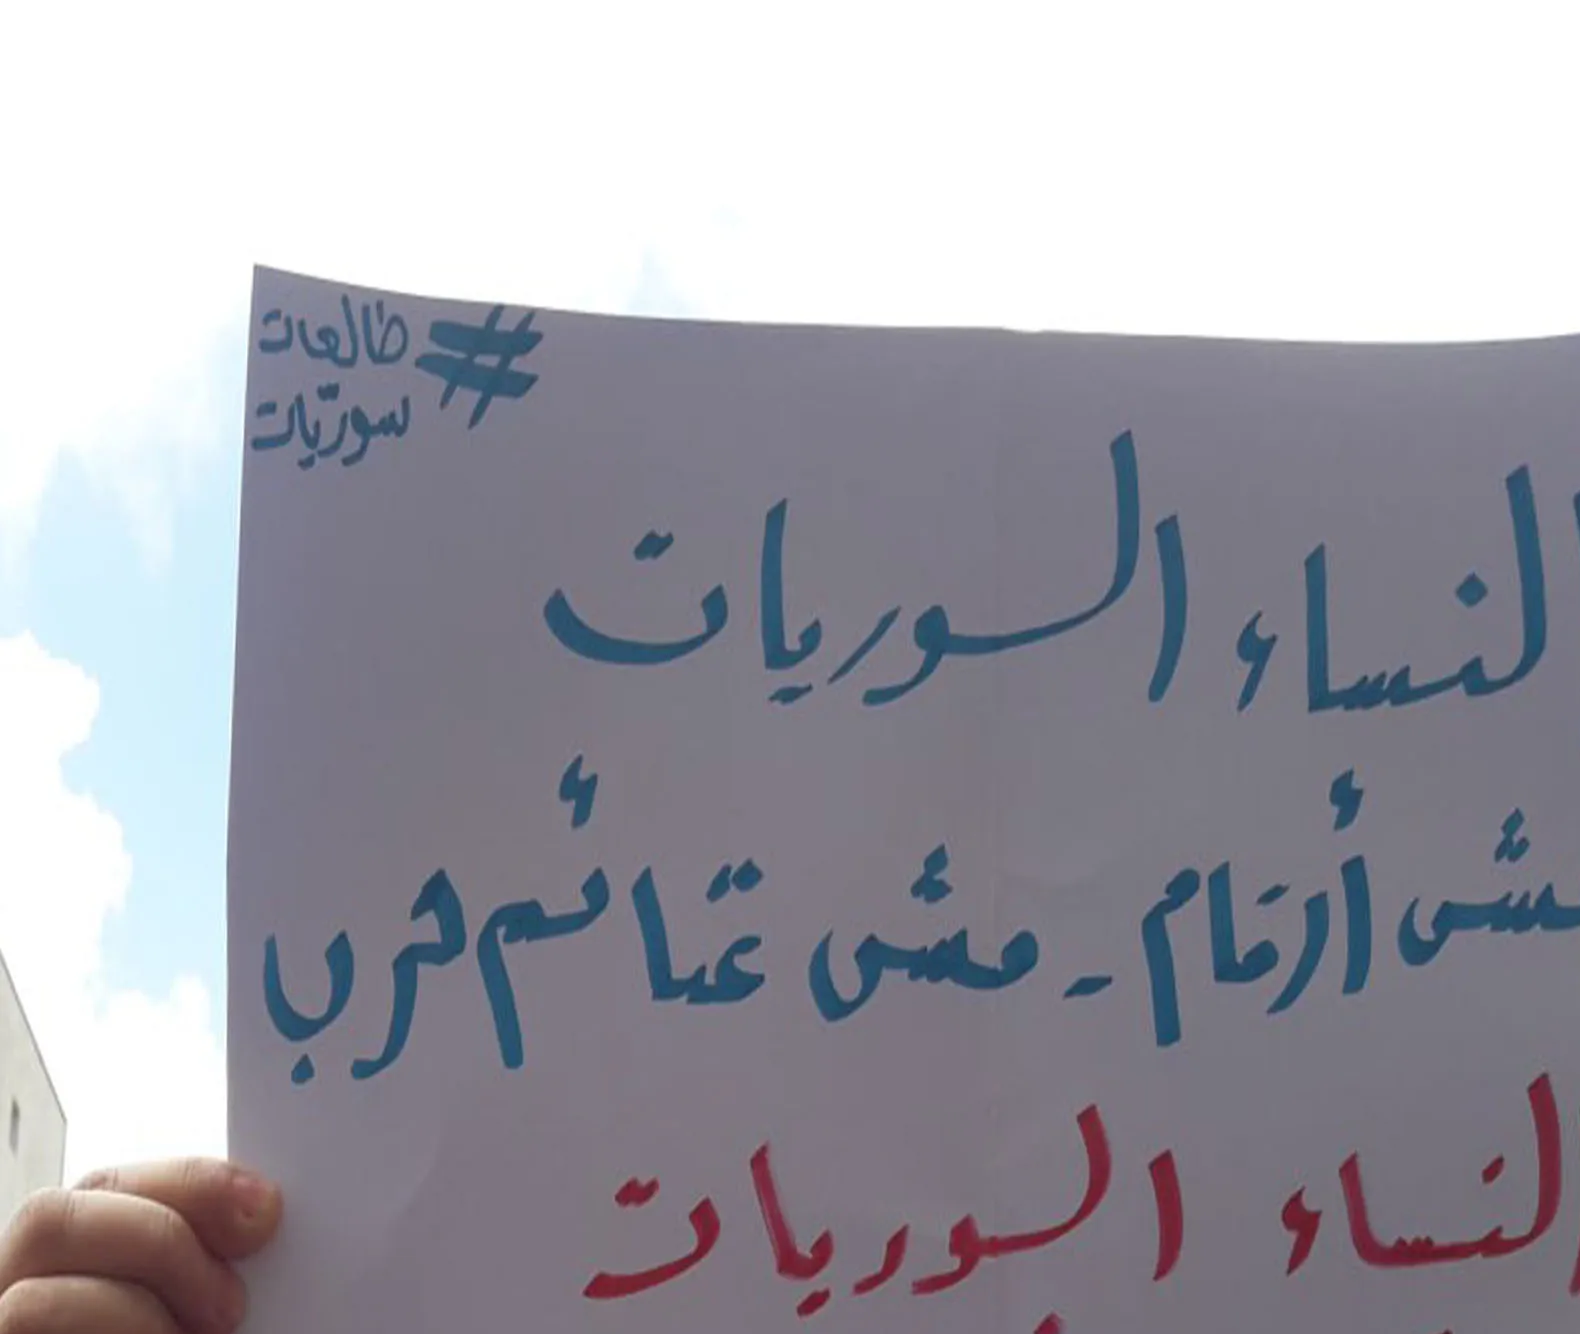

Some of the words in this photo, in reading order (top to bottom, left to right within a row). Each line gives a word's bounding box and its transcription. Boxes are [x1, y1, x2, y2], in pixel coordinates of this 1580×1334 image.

[544, 430, 1187, 706] السوريات
[264, 869, 467, 1084] حرب
[809, 844, 1039, 1022] مش
[1142, 769, 1372, 1047] أرقام
[583, 1104, 1183, 1317] السوريات
